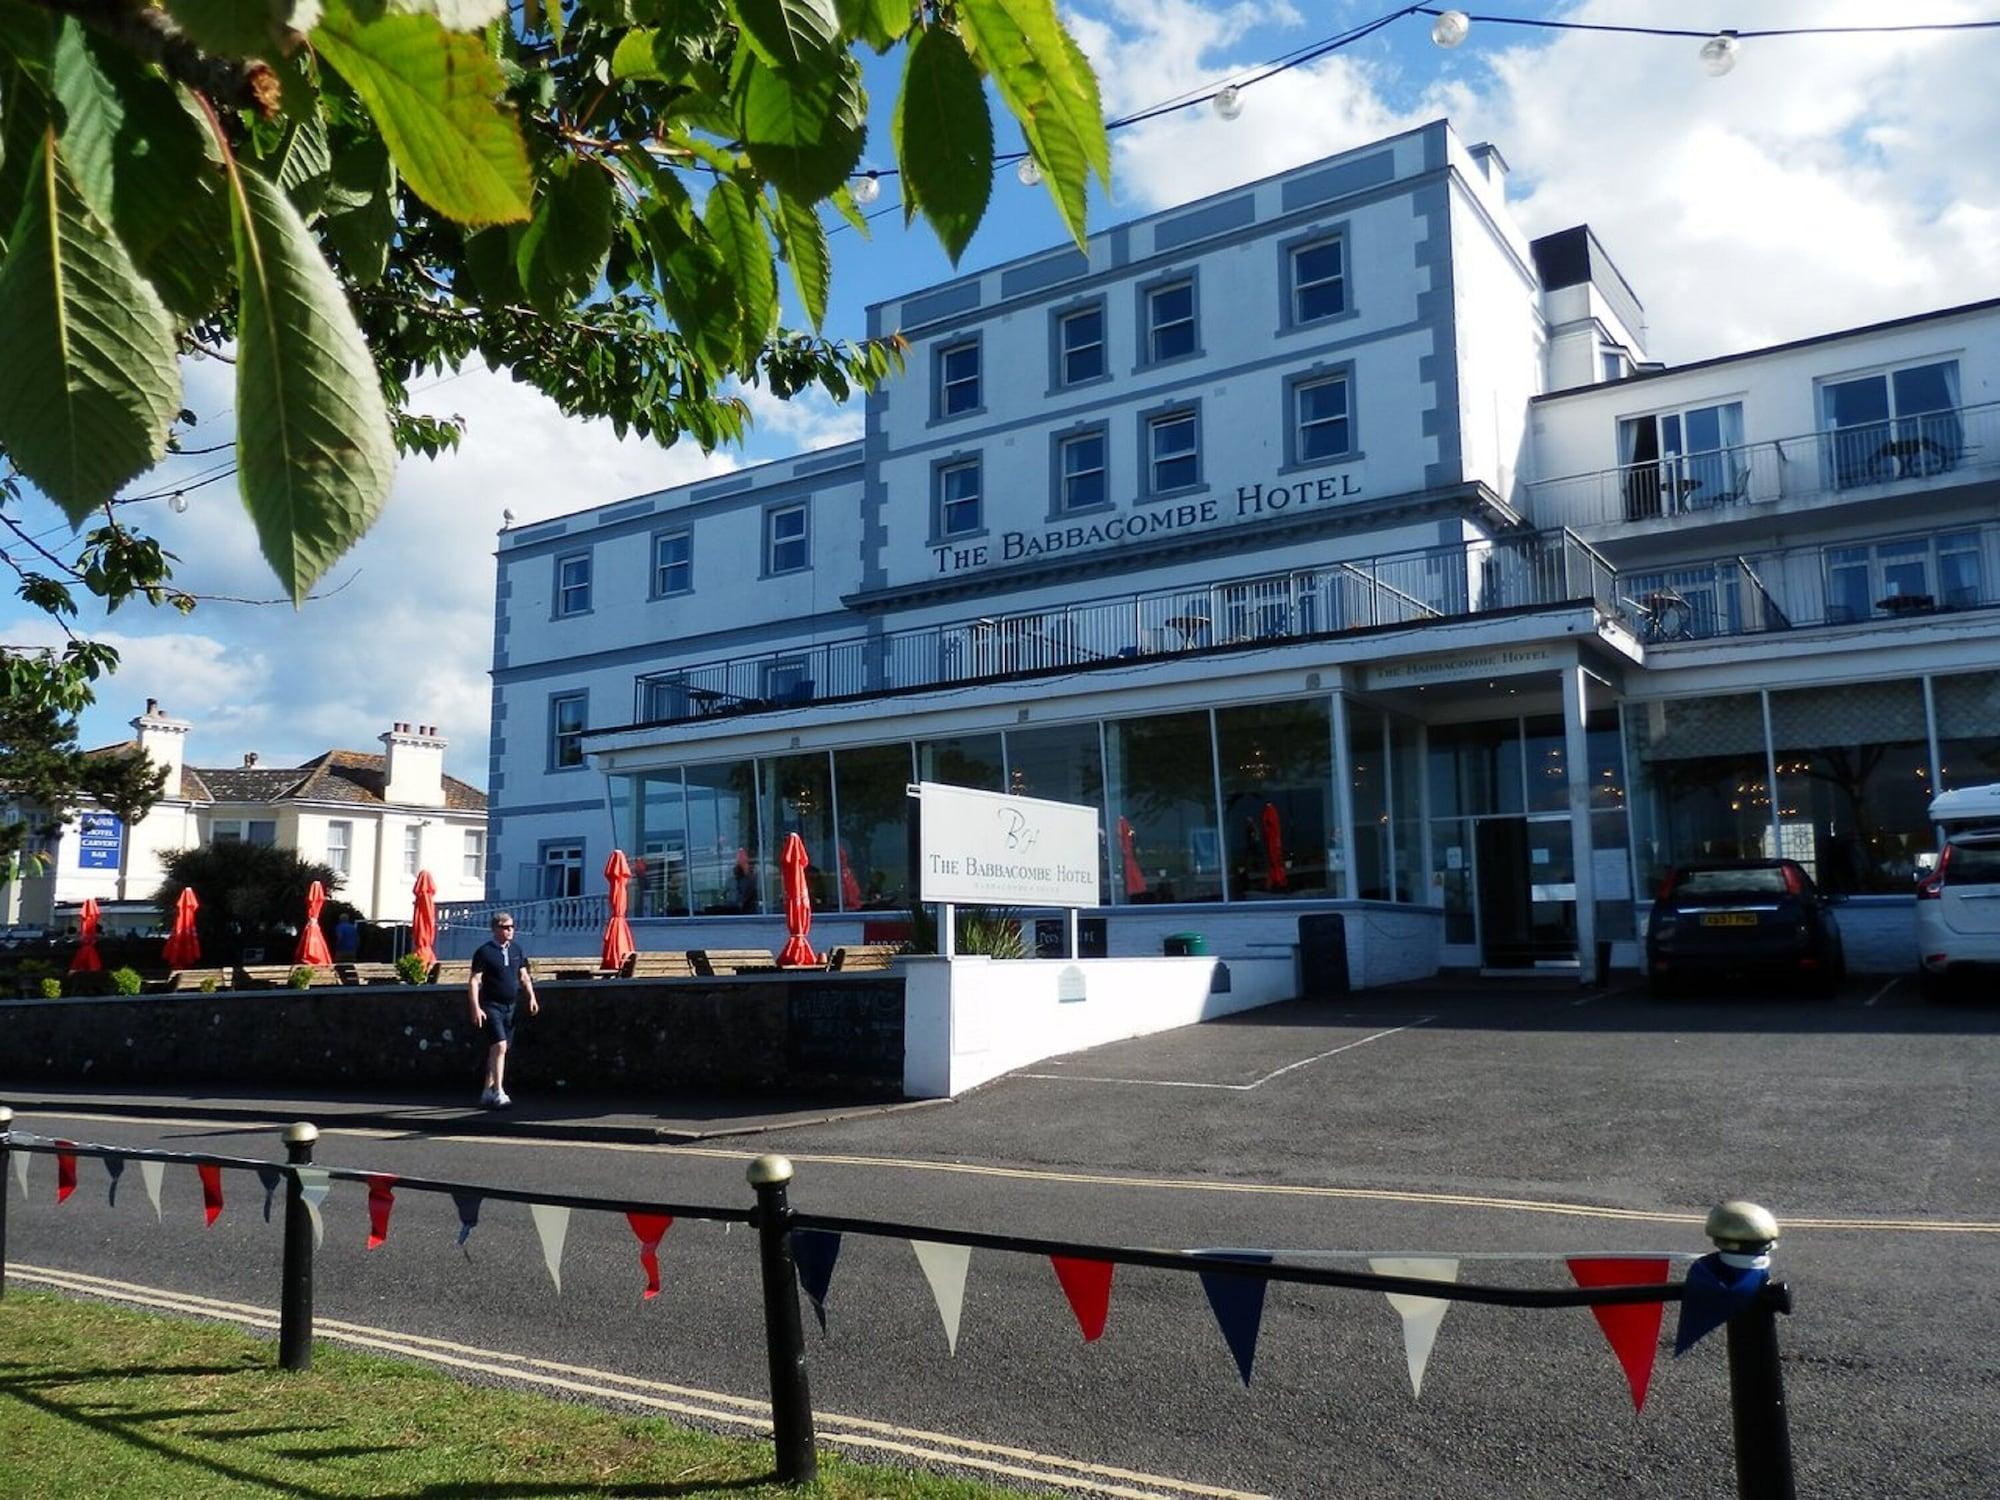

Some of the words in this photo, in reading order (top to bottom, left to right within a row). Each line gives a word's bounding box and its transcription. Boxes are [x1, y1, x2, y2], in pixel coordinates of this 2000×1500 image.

[933, 546, 987, 573] THE
[1003, 500, 1217, 561] BABBACOMBE
[1237, 474, 1362, 515] HOTEL
[1503, 650, 1550, 664] HOTEL
[930, 854, 959, 875] THE
[966, 857, 1052, 881] BABBACOMBE
[1057, 865, 1093, 884] HOTEL
